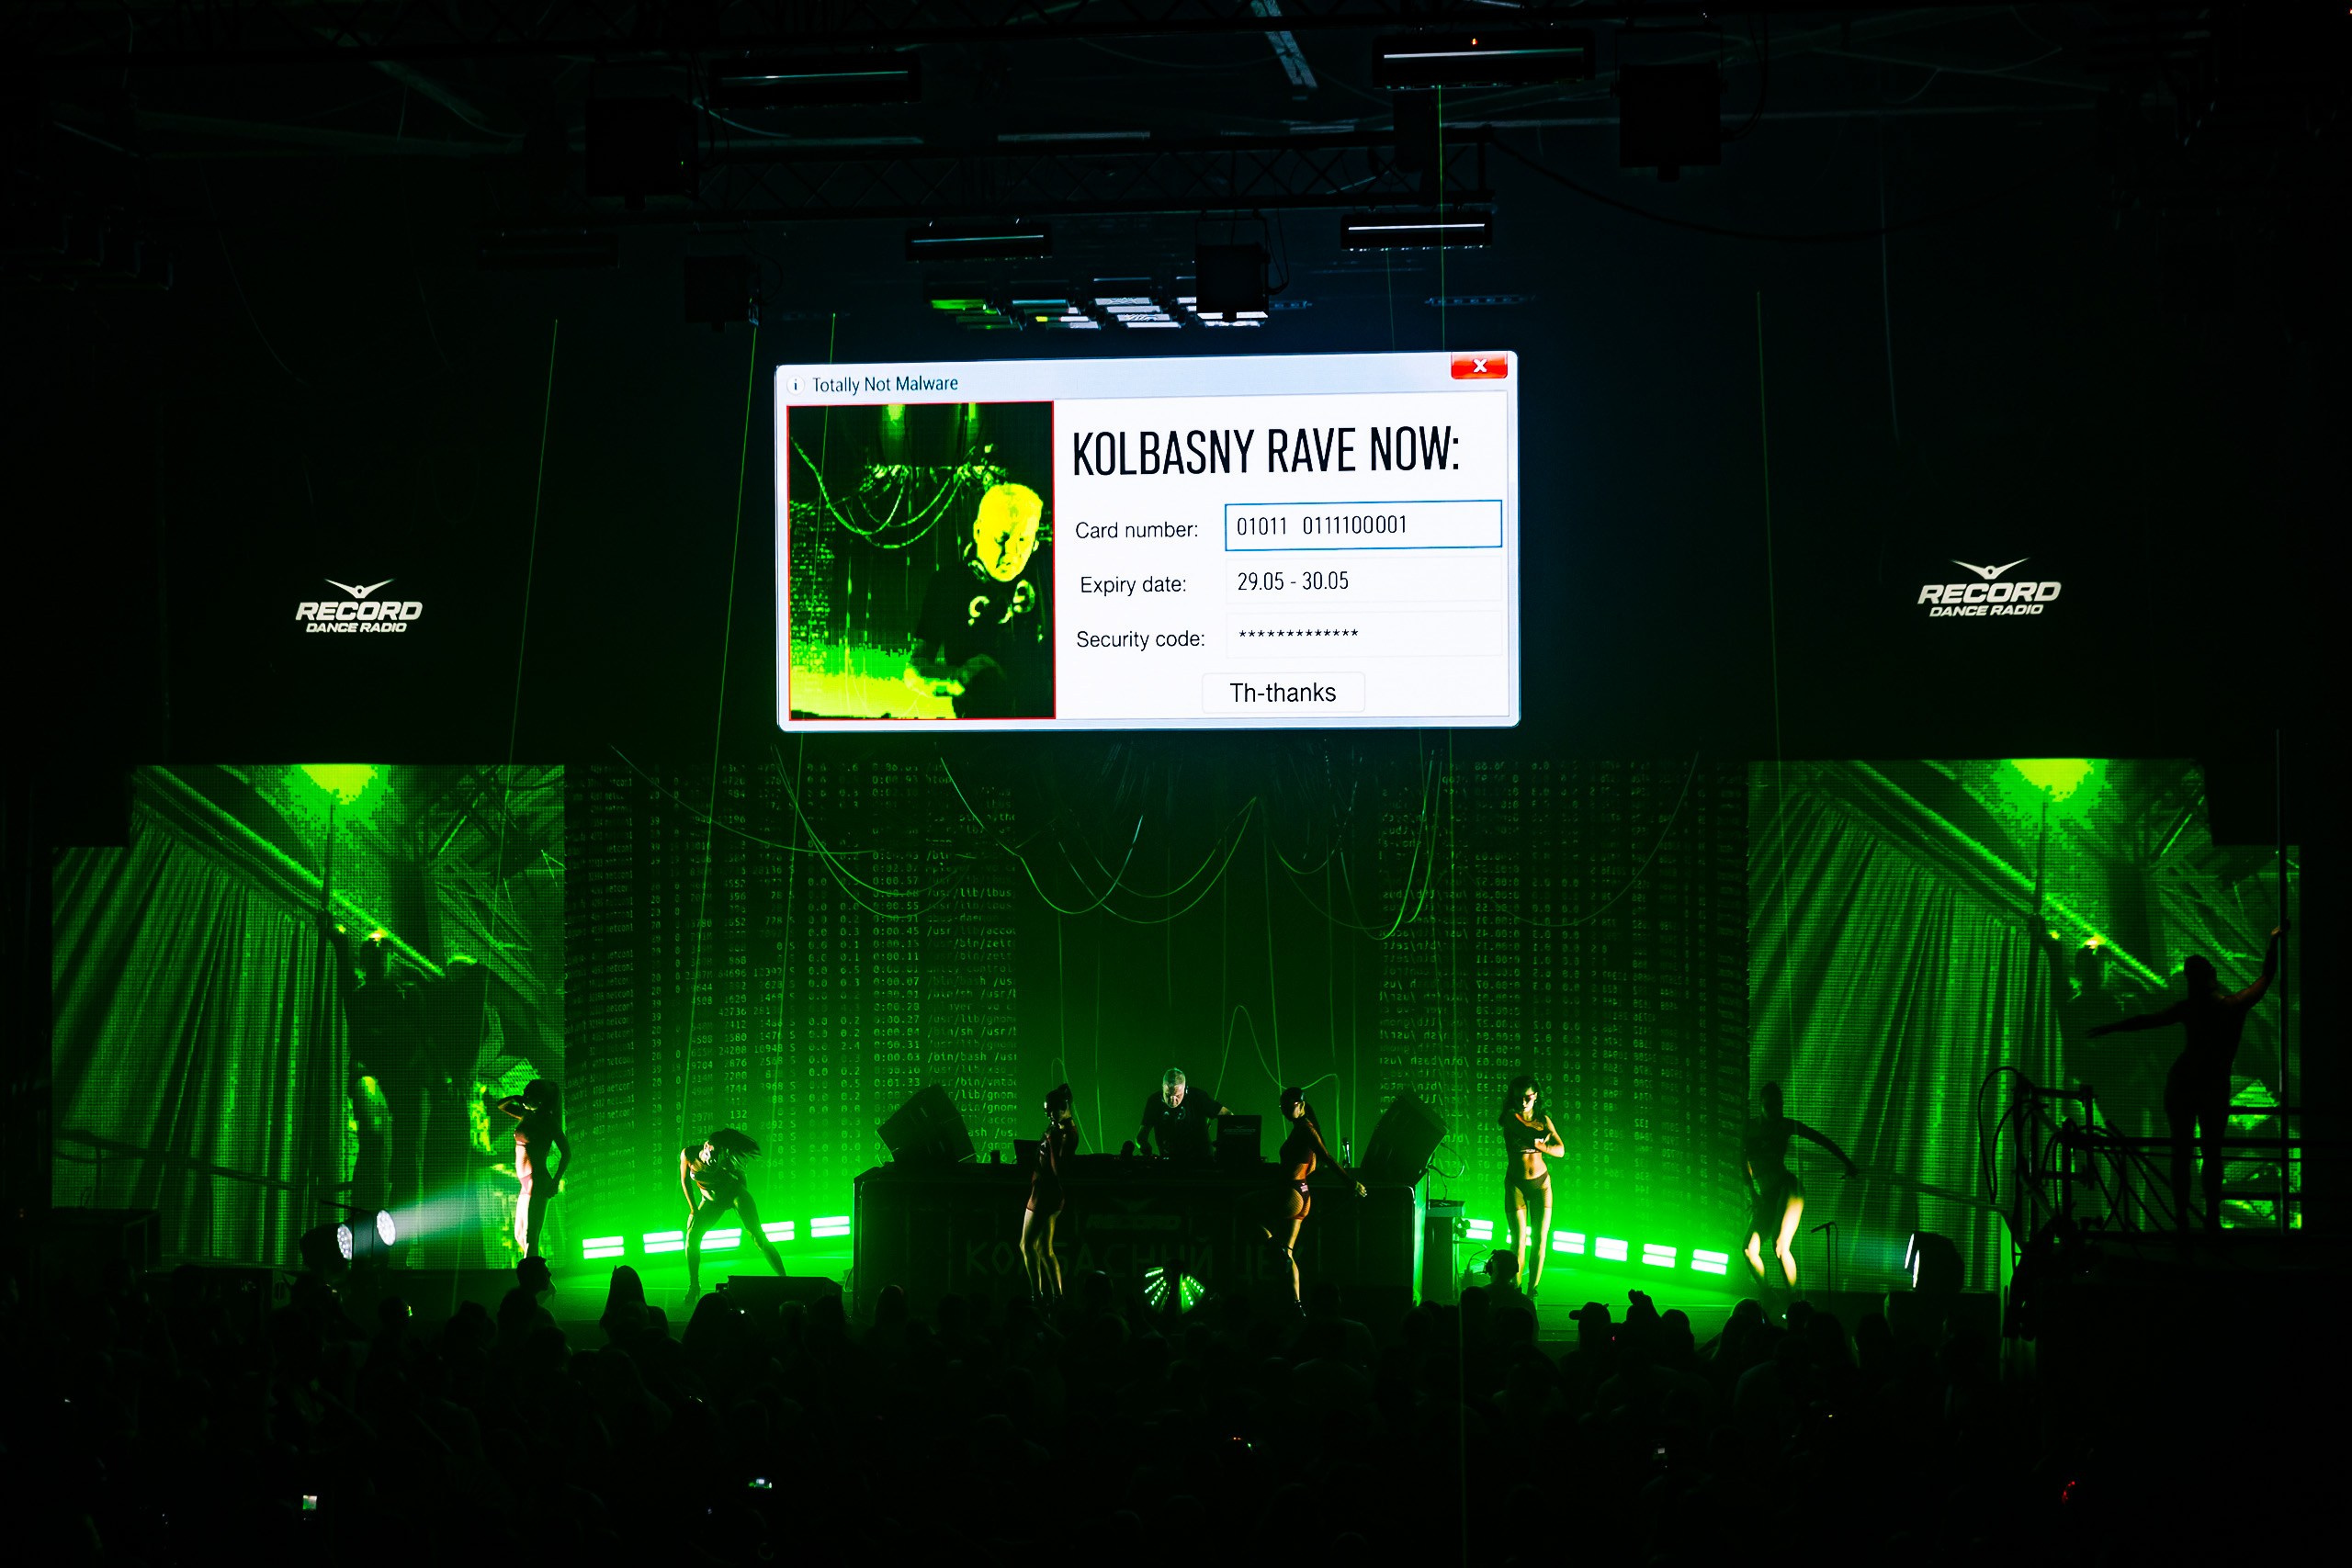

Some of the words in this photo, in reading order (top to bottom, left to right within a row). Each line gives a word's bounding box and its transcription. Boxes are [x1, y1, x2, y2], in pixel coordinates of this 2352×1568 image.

[812, 377, 860, 396] Totally
[865, 376, 891, 392] Not
[896, 375, 959, 391] Malware
[1074, 429, 1255, 476] KOLBASNY
[1268, 427, 1356, 473] RAVE
[1371, 425, 1460, 470] NOW:
[1075, 522, 1121, 540] Card
[1125, 521, 1199, 539] number:
[1237, 516, 1286, 536] 01011
[1303, 514, 1407, 535] 0111100001
[1080, 576, 1136, 597] Expiry
[1142, 575, 1186, 593] date:
[1238, 572, 1284, 591] 29.05
[1302, 570, 1349, 590] 30.05
[1917, 581, 2062, 604] RECORD
[295, 601, 424, 621] RECORD
[1929, 604, 1989, 617] DANCE
[1989, 604, 2044, 616] RADIO
[305, 622, 358, 633] DANCE
[359, 622, 408, 633] RADIO
[1077, 630, 1148, 651] Security
[1155, 630, 1205, 648] code:
[1229, 682, 1337, 704] Th-thanks
